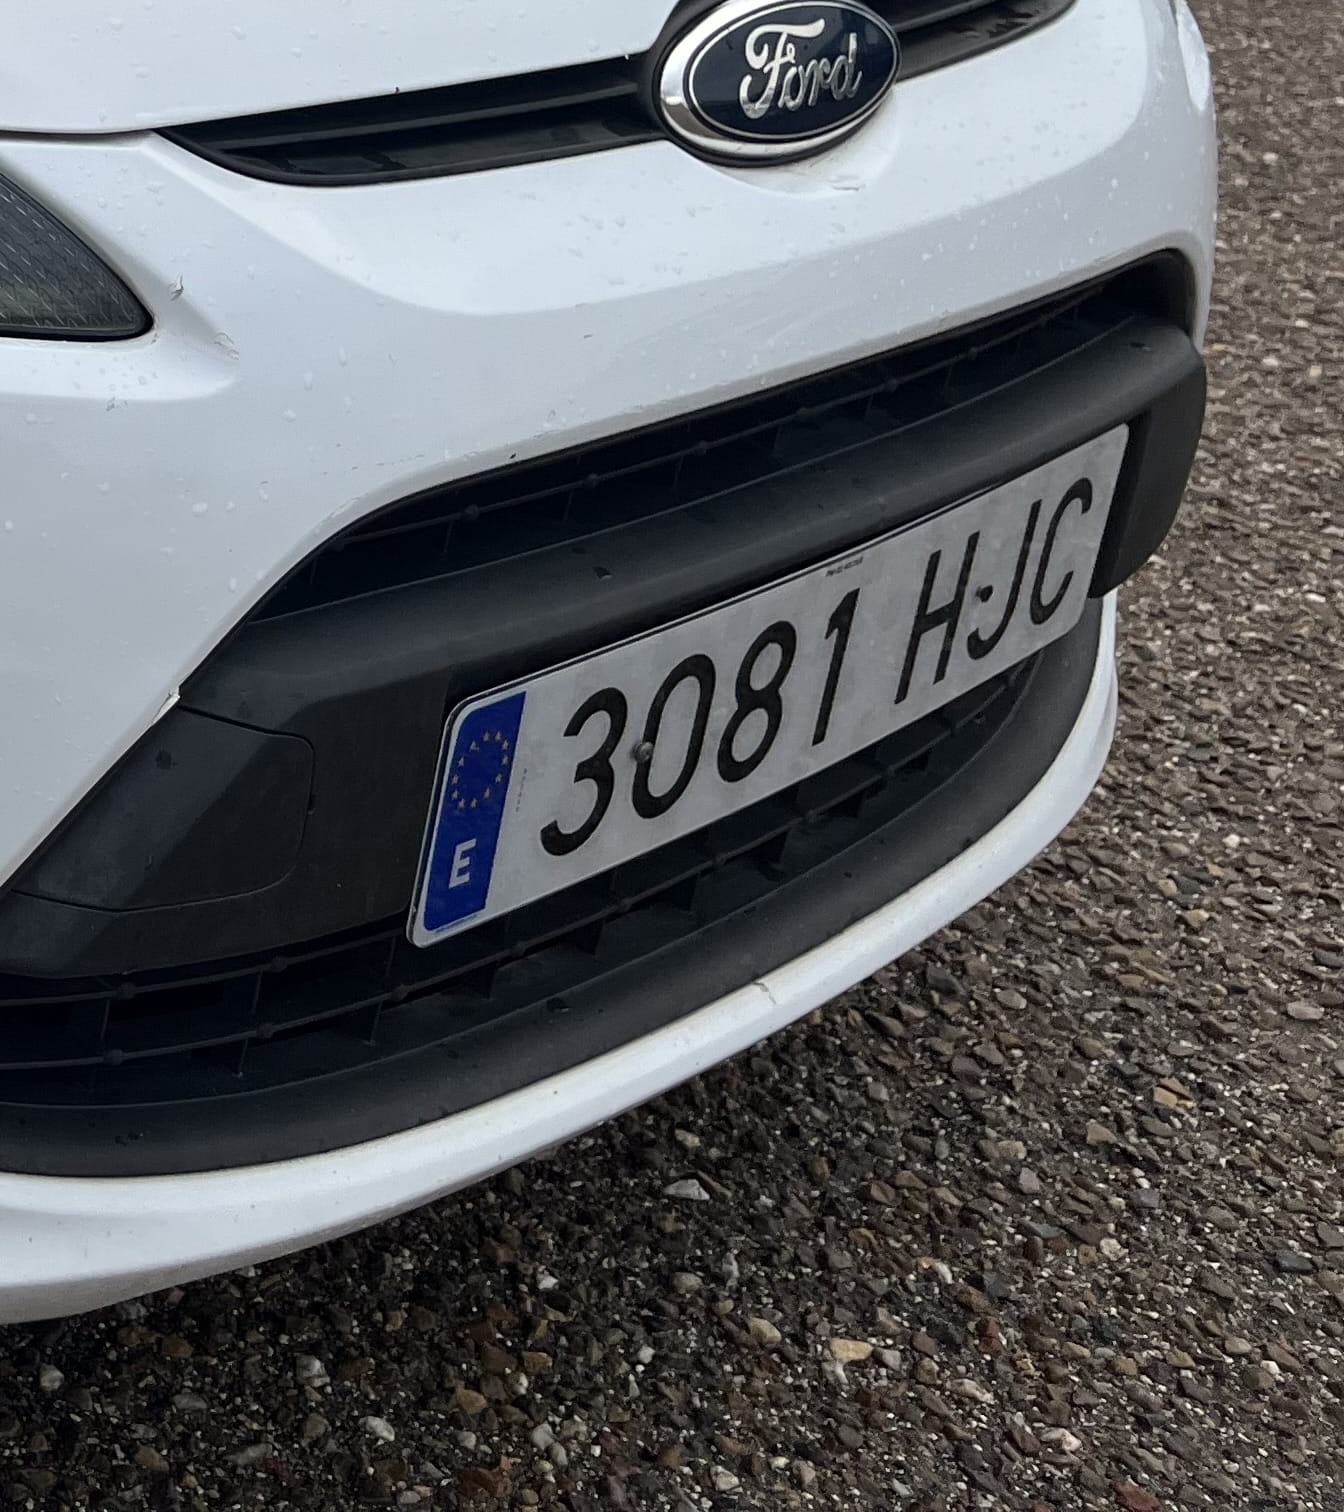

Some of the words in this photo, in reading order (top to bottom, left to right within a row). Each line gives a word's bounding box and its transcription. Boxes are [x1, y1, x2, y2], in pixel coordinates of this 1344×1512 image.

[738, 18, 864, 120] Ford
[540, 588, 860, 857] 3081
[894, 477, 1093, 705] HJC
[448, 838, 477, 889] E
